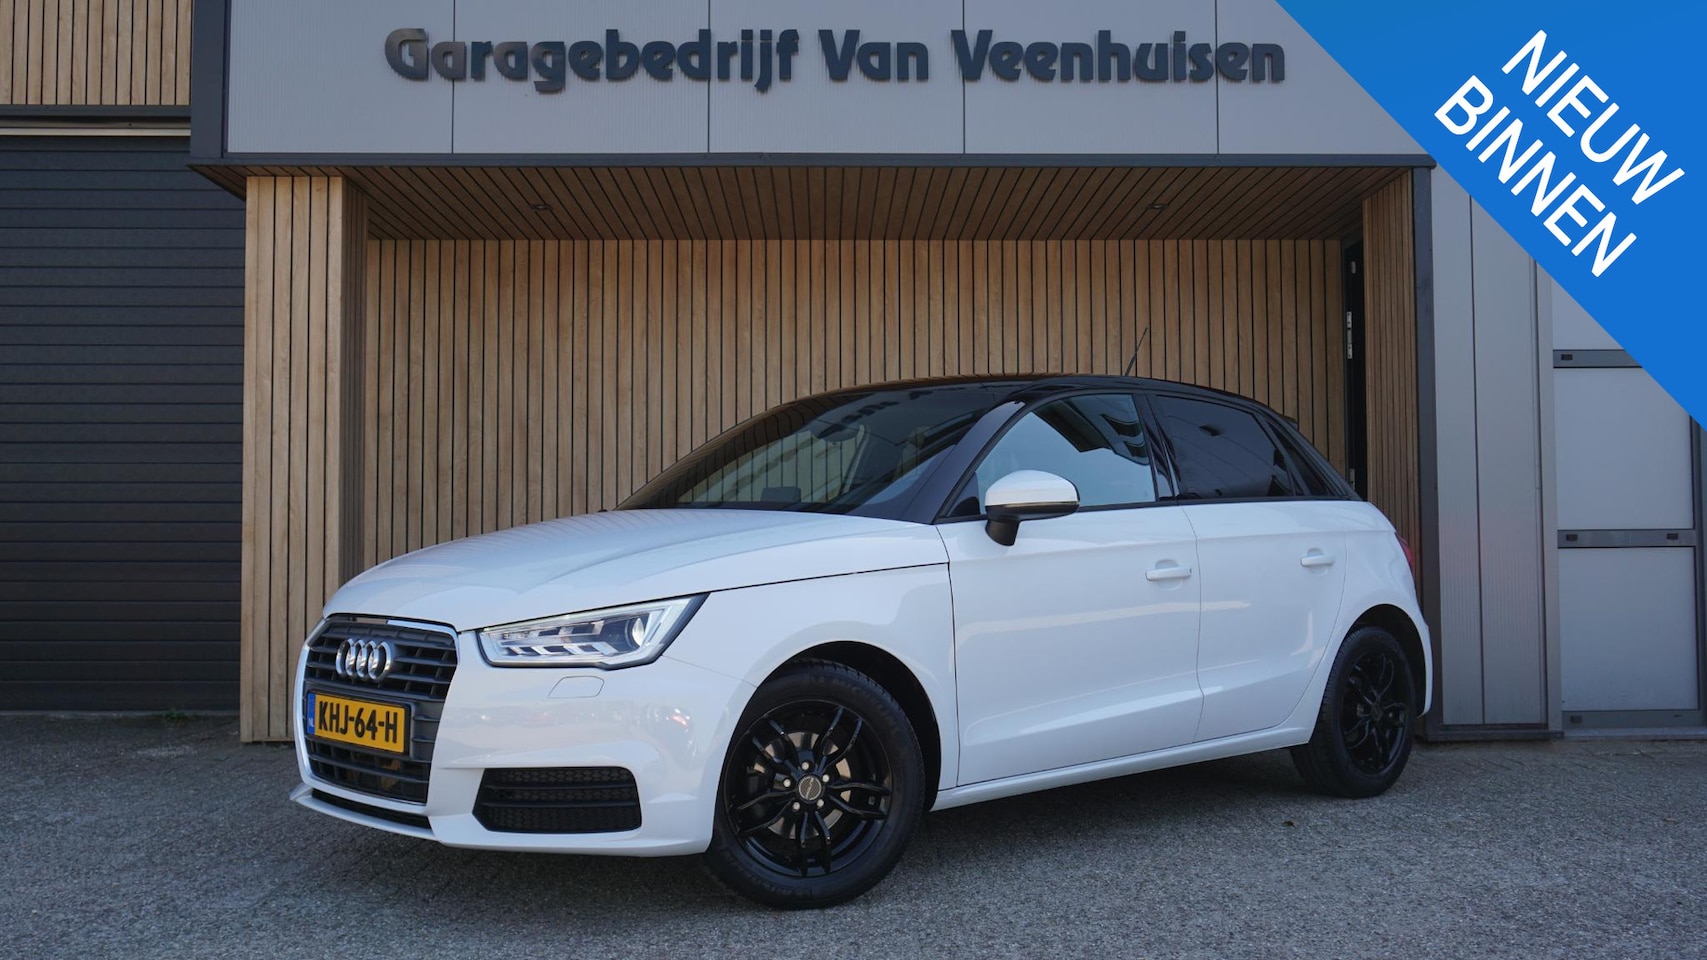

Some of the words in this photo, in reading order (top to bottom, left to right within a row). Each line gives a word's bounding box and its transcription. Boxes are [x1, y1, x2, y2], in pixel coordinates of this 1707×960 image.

[384, 28, 800, 93] Garagebedrijf
[817, 29, 929, 81] Van
[950, 29, 1286, 82] Veenhuisen
[318, 701, 398, 743] KHJ-64-H
